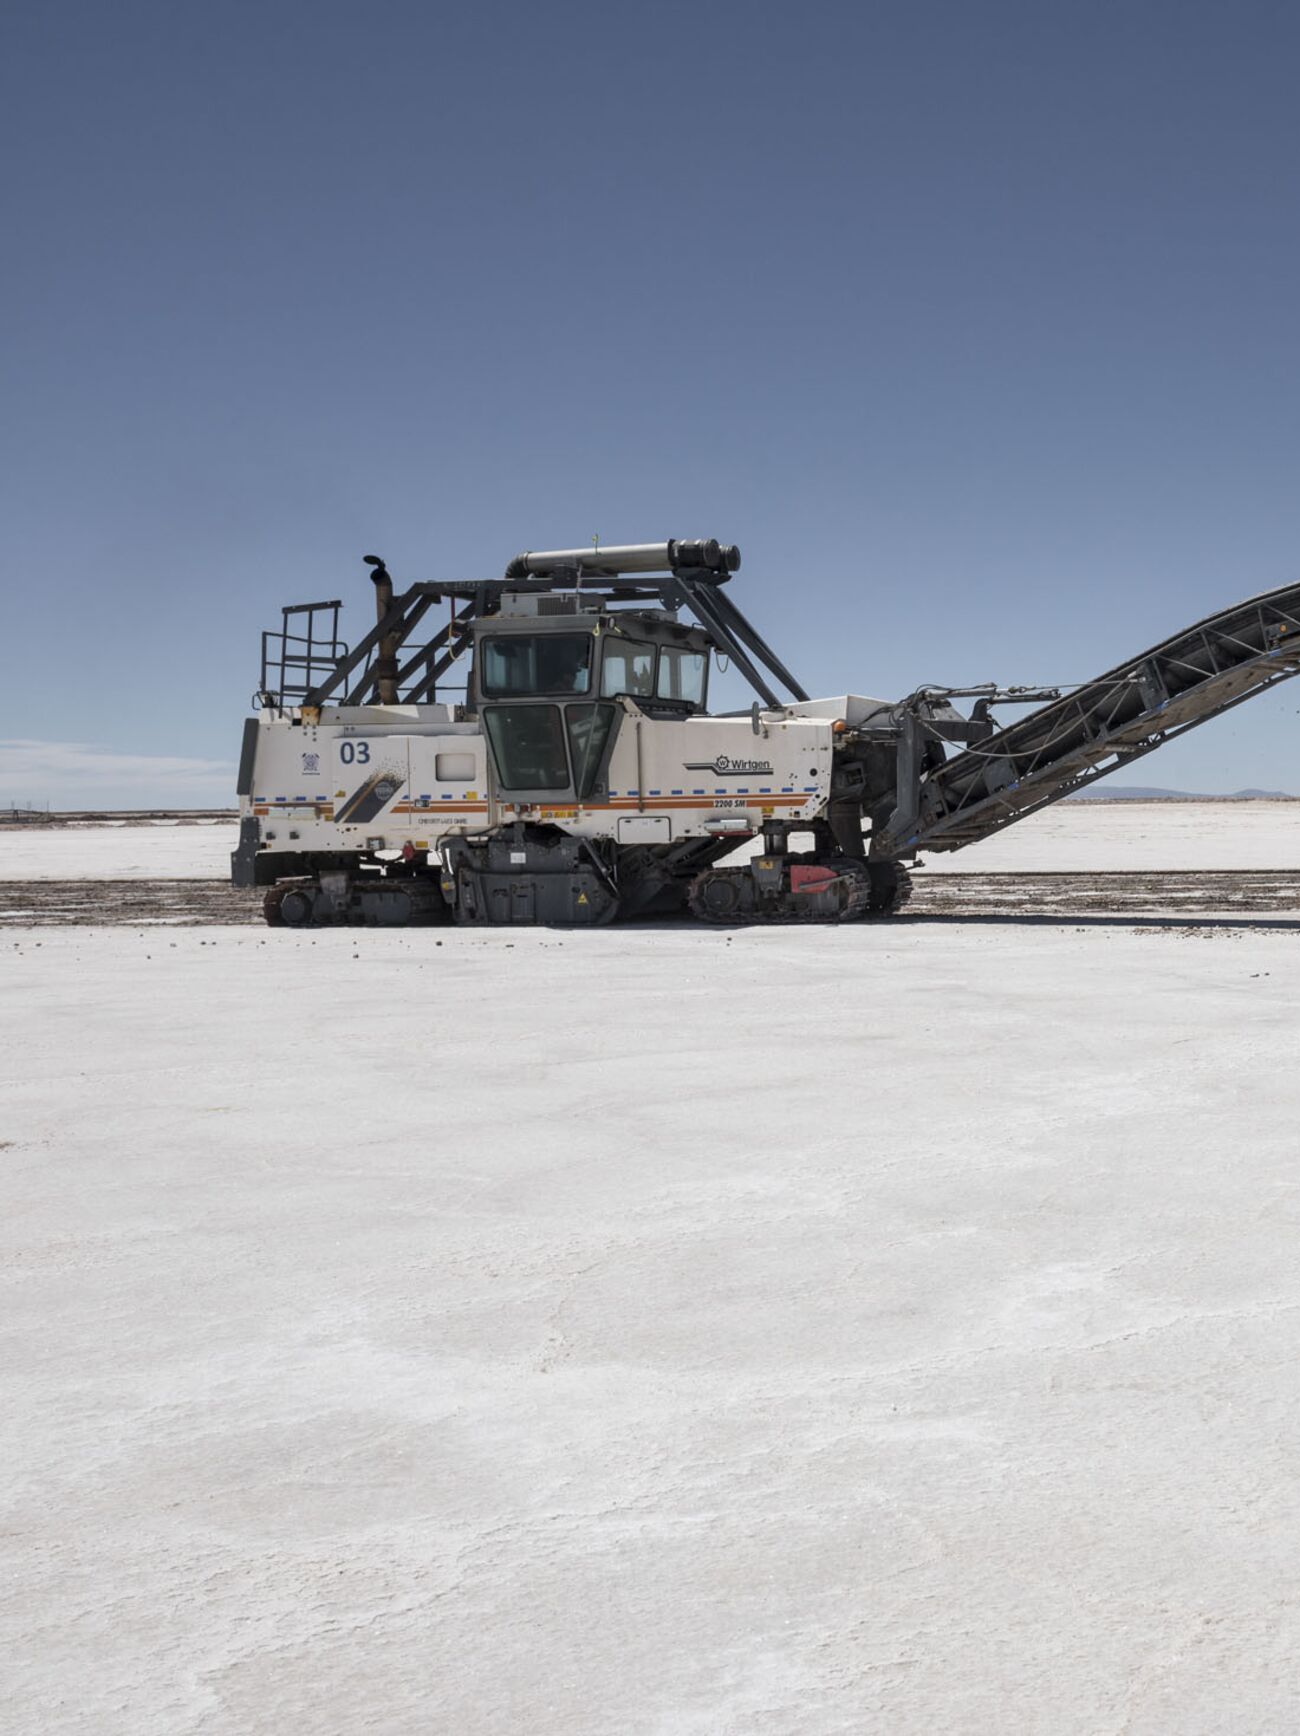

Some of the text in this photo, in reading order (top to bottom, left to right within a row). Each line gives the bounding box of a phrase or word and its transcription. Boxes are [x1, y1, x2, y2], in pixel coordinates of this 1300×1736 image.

[340, 741, 370, 764] 03
[731, 760, 770, 770] Wirtgen
[714, 799, 746, 808] 2200 SM
